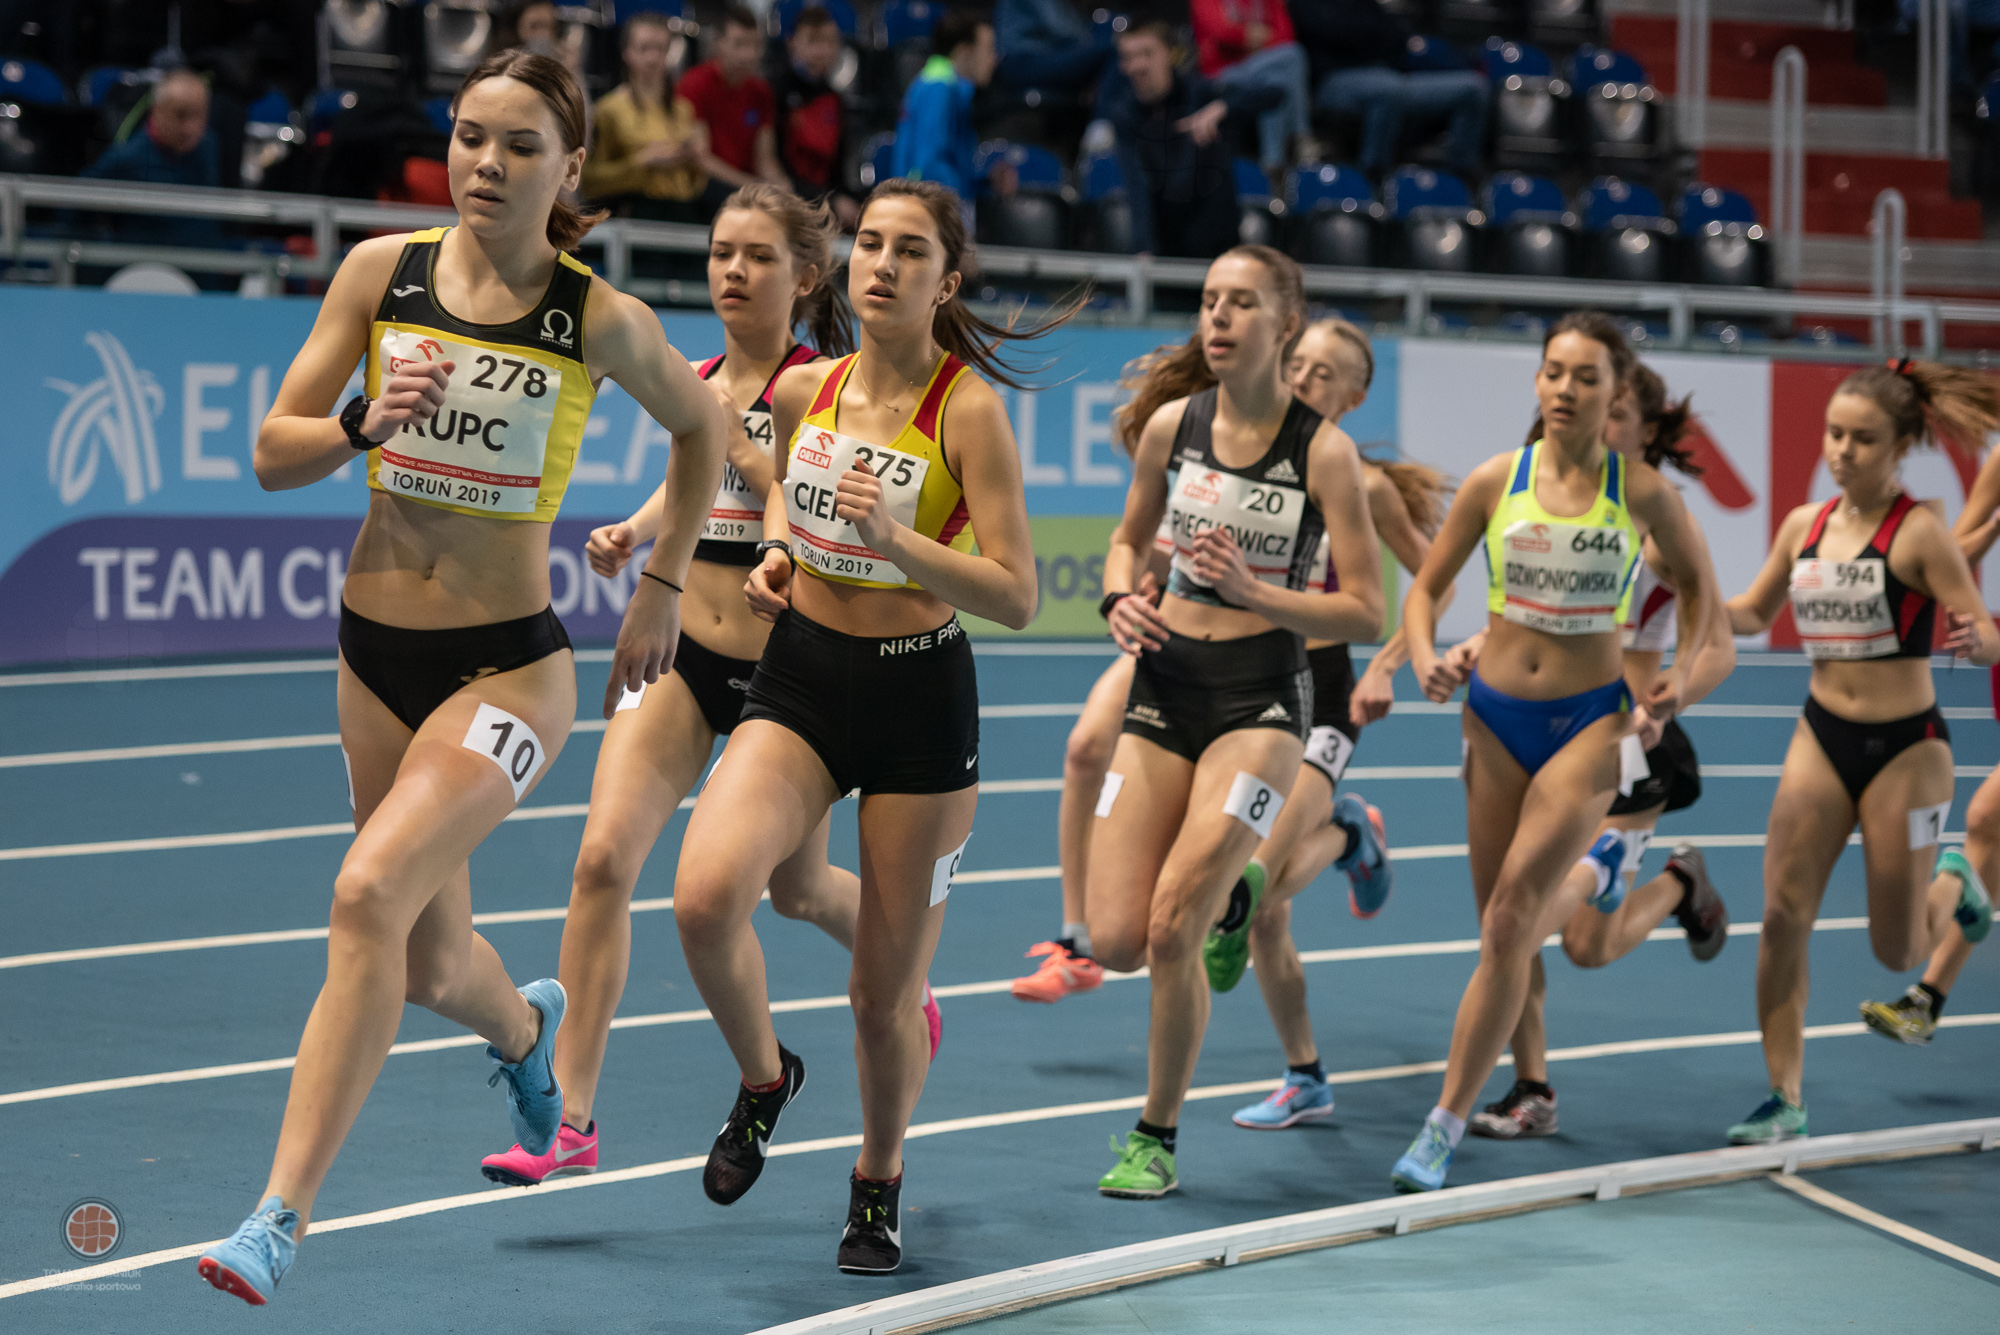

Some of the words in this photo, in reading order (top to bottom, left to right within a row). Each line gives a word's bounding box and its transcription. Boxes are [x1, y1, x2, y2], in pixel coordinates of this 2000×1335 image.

[470, 354, 548, 398] 278
[799, 450, 831, 467] ORLEN
[851, 447, 916, 487] 375
[393, 471, 452, 498] TORUŃ
[456, 485, 502, 506] 2019
[1248, 489, 1284, 515] 20
[713, 522, 745, 537] 2019
[1571, 530, 1622, 555] 644
[800, 543, 831, 569] TORUŃ
[834, 558, 873, 575] 2019
[78, 547, 264, 621] TEAM
[1836, 564, 1875, 588] 594
[880, 635, 932, 656] NIKE
[490, 721, 535, 783] 10
[1321, 734, 1341, 764] 3
[1250, 788, 1271, 821] 8
